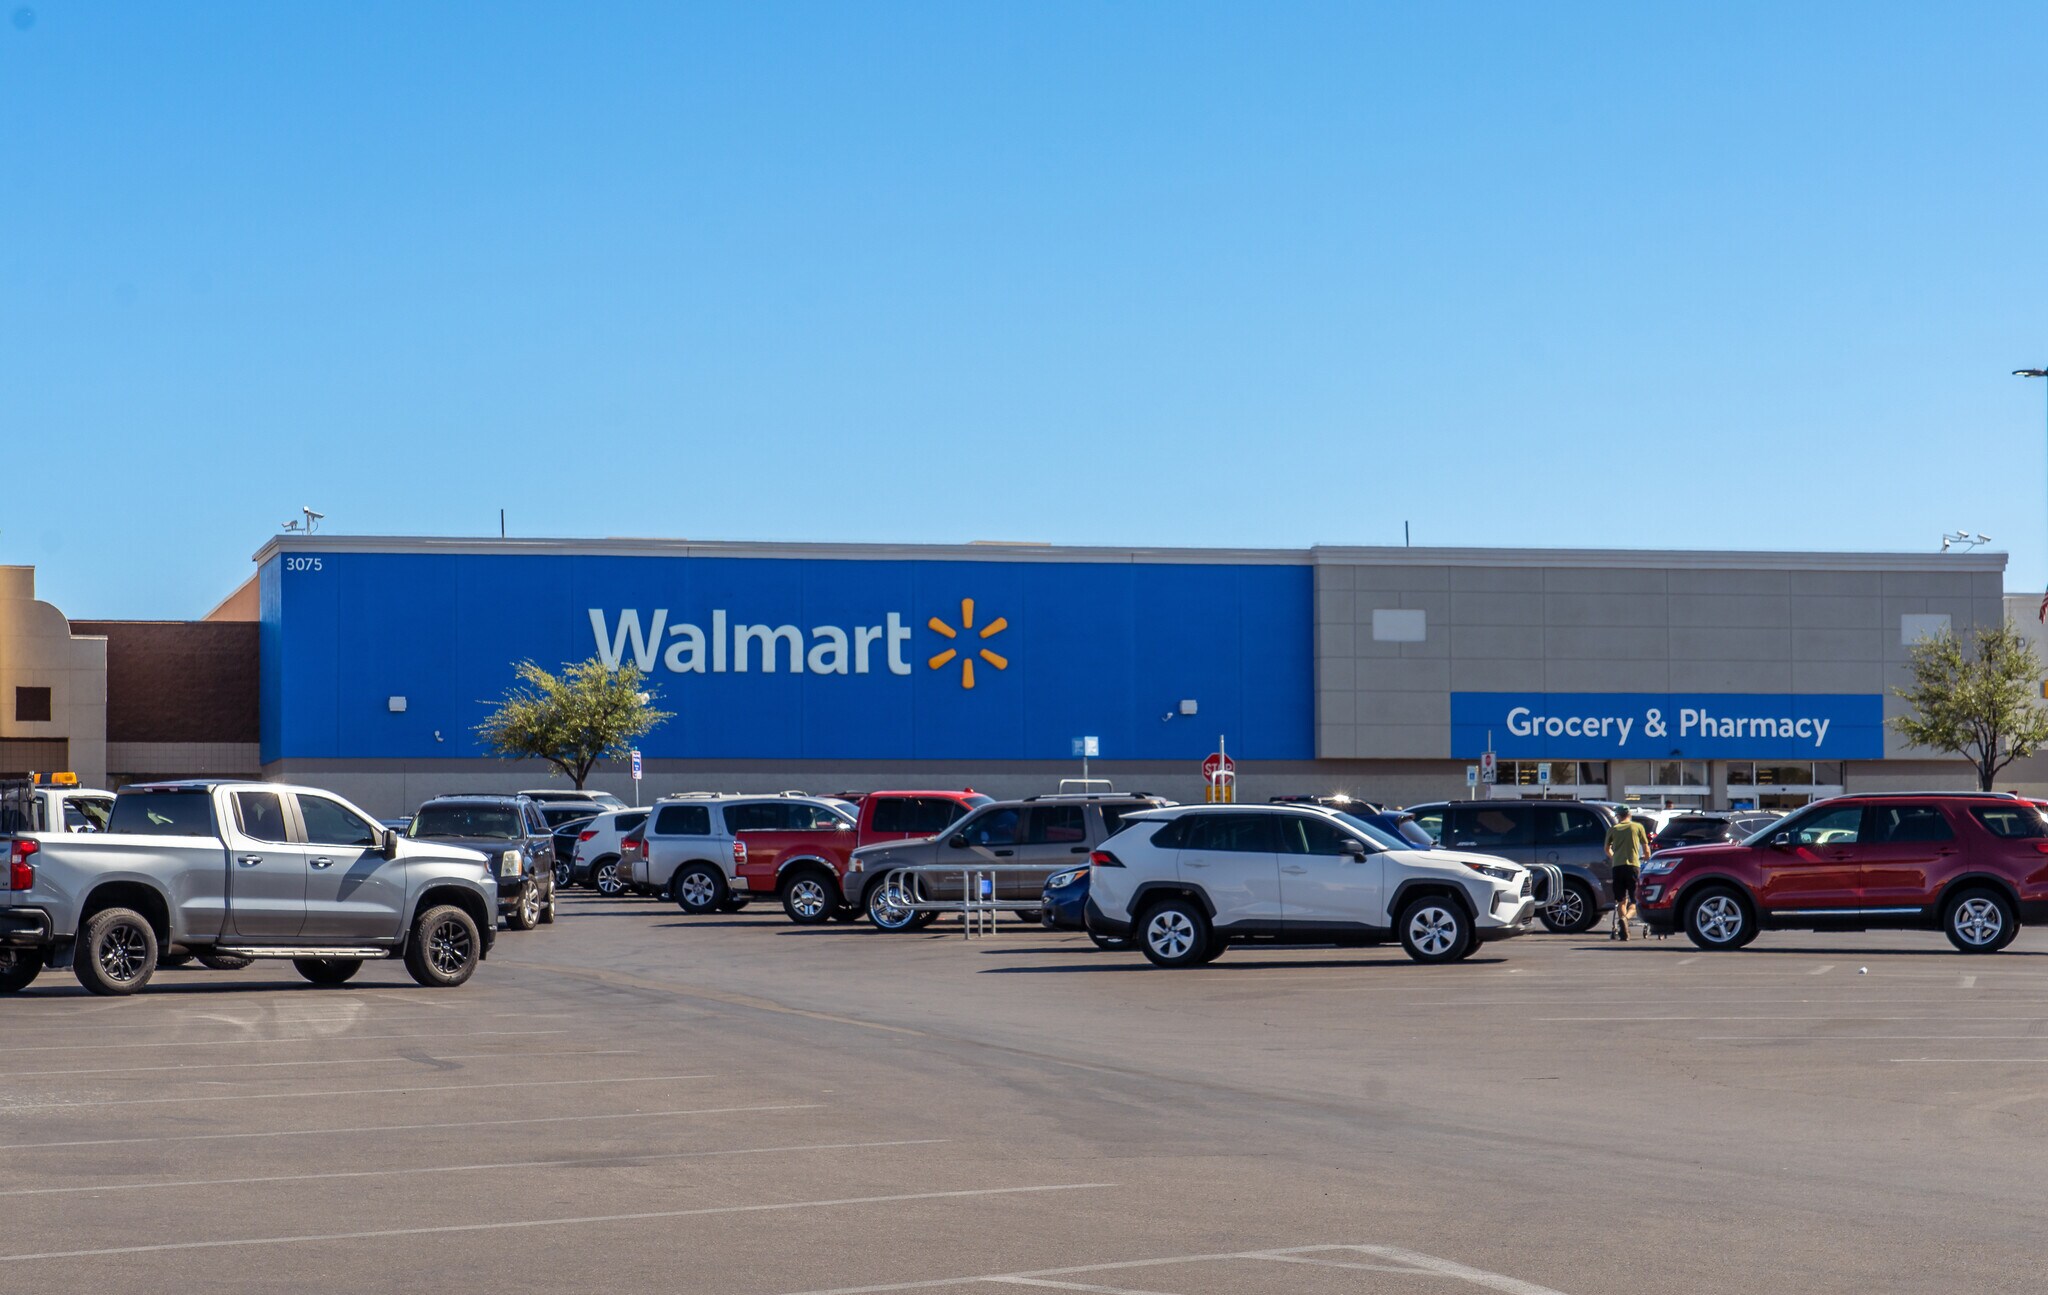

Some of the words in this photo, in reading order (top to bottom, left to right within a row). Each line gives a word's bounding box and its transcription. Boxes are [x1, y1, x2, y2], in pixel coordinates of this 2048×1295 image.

[286, 557, 323, 571] 3075
[588, 608, 912, 675] Walmart
[1506, 706, 1634, 746] Grocery
[1644, 708, 1668, 738] &
[1680, 708, 1831, 747] Pharmacy
[1204, 762, 1233, 776] STP
